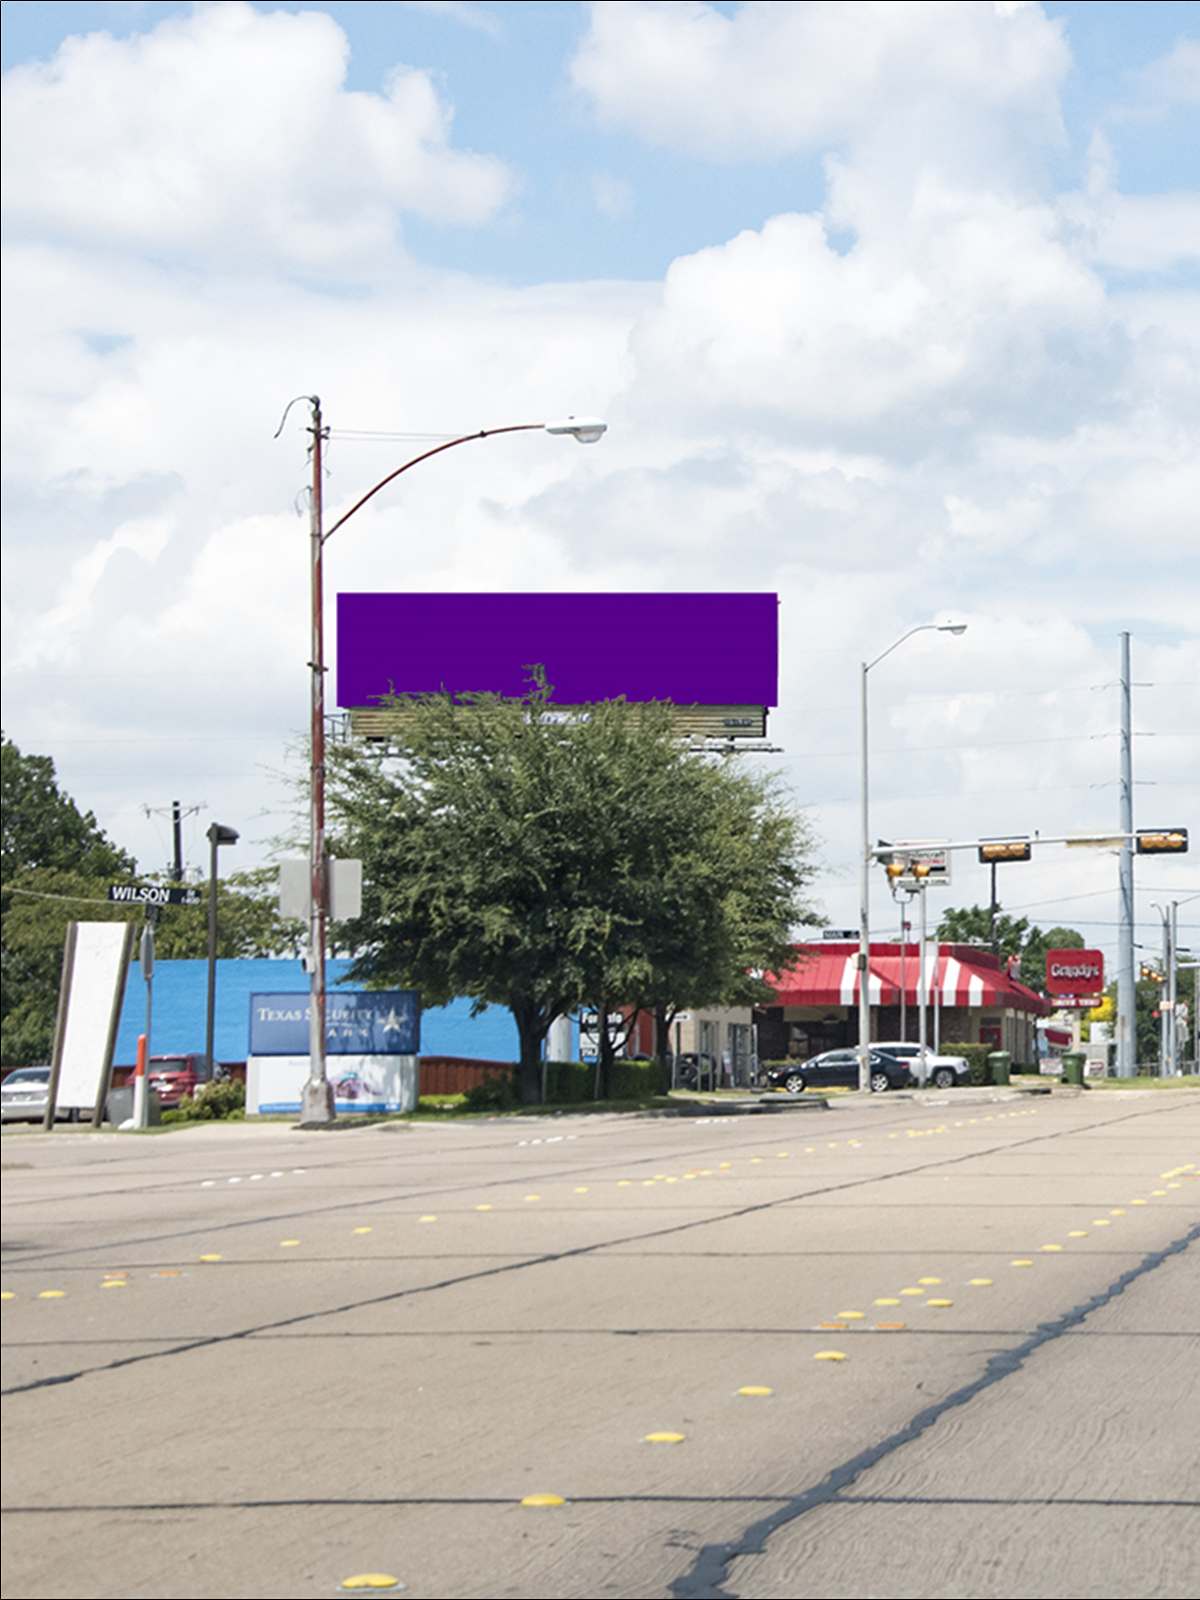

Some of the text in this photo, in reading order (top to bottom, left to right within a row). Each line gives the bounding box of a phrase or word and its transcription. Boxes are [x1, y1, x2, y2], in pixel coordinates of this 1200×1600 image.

[112, 886, 170, 902] WILSON
[1051, 963, 1100, 978] Grandy's
[257, 1007, 373, 1021] TEXAS SCURITY
